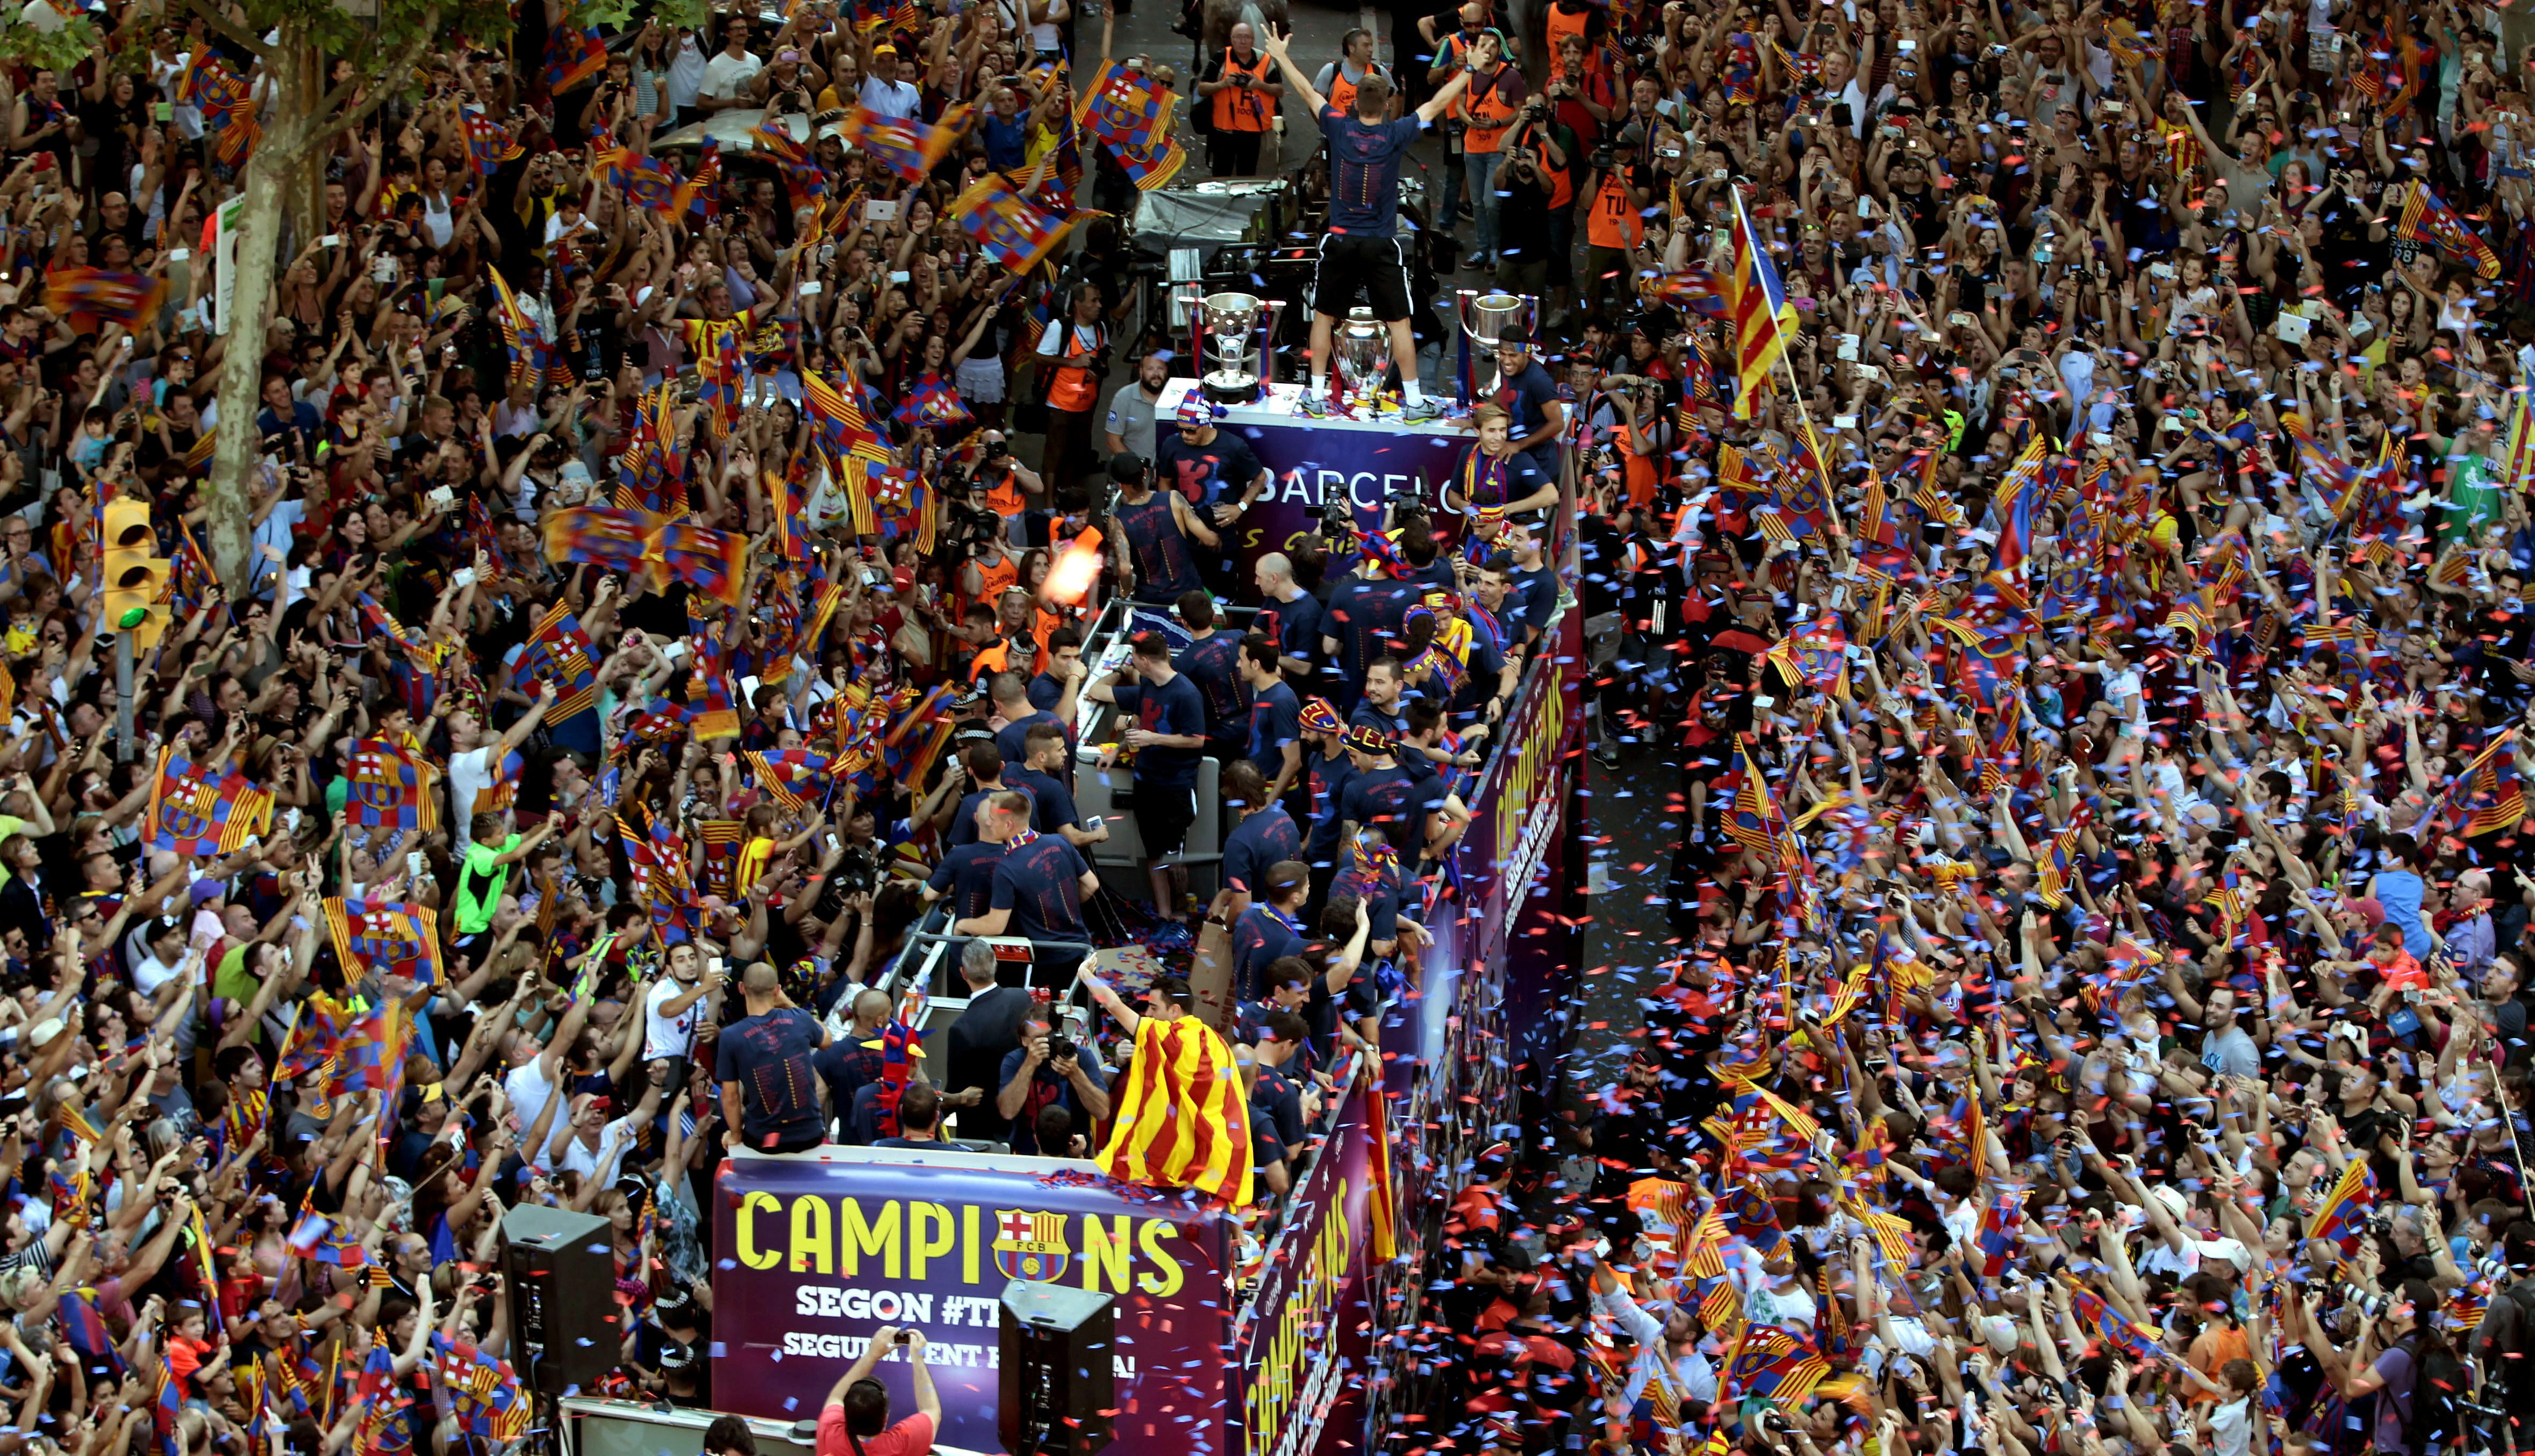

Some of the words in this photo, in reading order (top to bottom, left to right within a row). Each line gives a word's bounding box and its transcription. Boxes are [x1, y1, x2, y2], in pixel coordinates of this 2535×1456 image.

[2389, 239, 2422, 249] GUESS
[180, 803, 199, 815] FCB
[382, 932, 405, 941] FCB
[735, 1190, 1184, 1298] CAMPINS
[1017, 1242, 1046, 1252] FCB
[796, 1285, 934, 1324] SEGON
[1750, 1345, 1771, 1353] FCB
